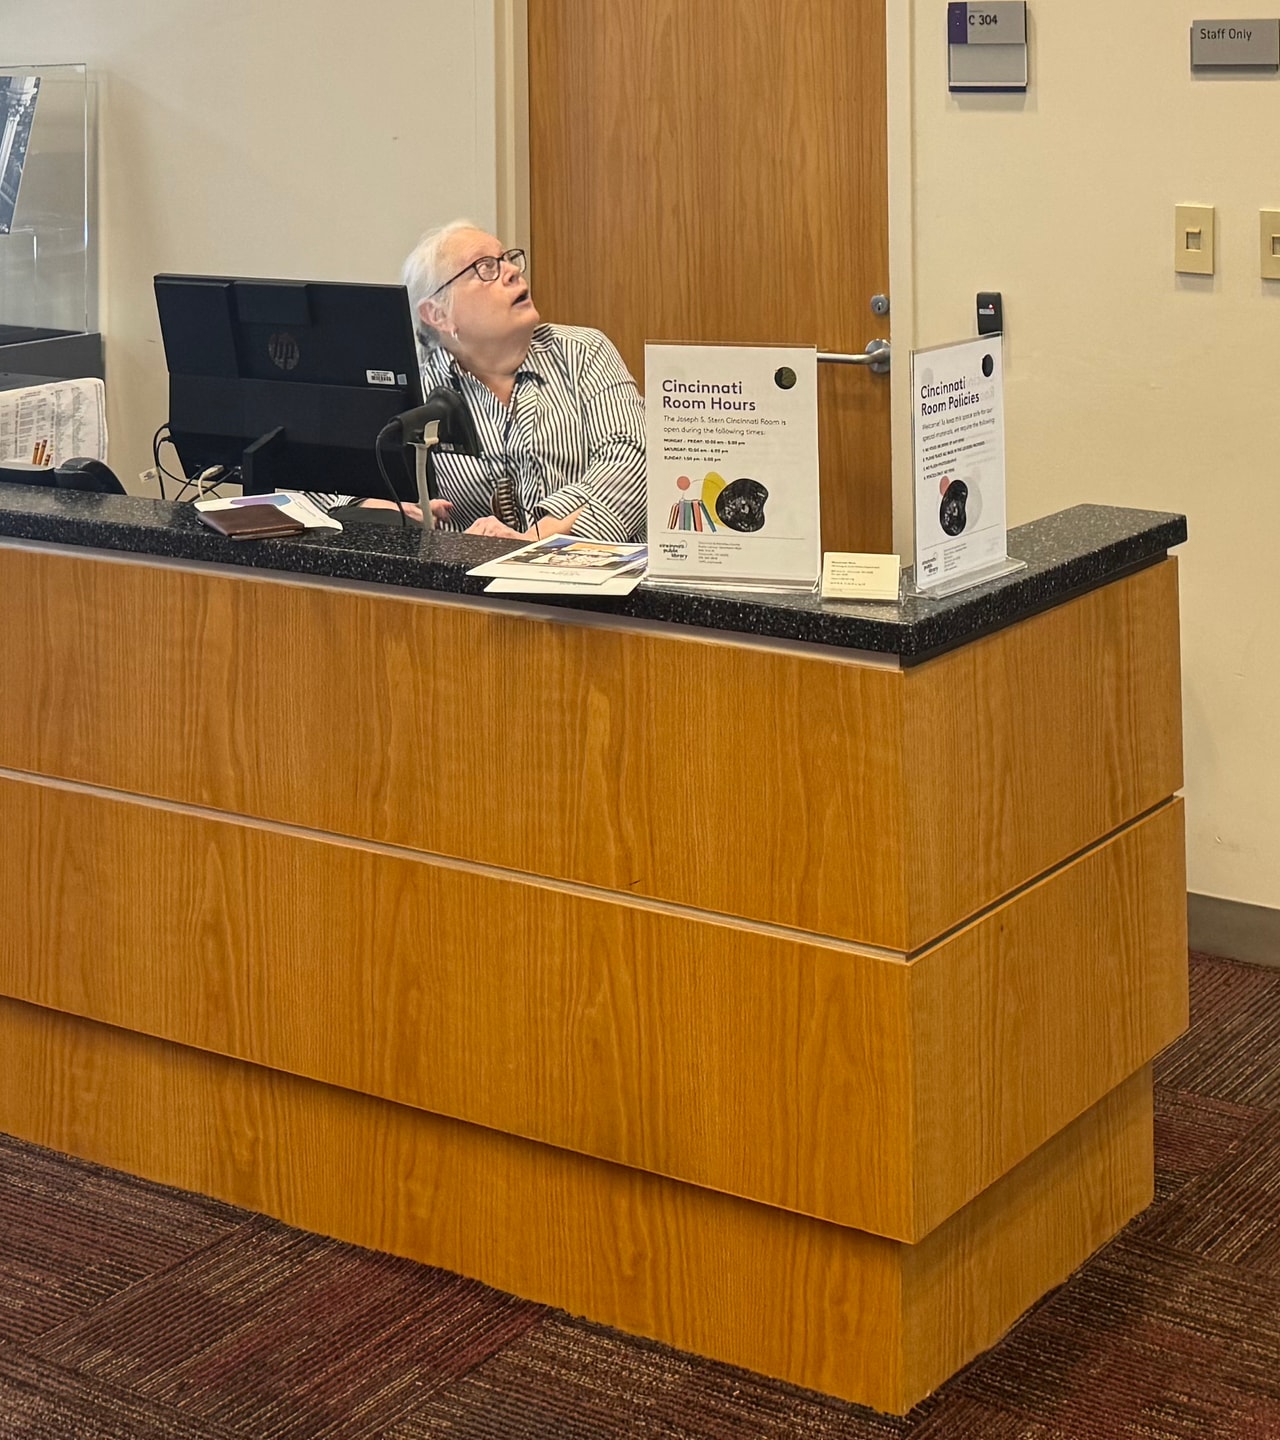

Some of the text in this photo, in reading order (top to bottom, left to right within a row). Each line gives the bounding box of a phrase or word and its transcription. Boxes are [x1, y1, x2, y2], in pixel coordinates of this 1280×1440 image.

[968, 14, 998, 26] C 304
[1200, 28, 1252, 42] Staff Only
[662, 379, 742, 394] Cincinnati
[921, 376, 966, 399] Cincinnati
[663, 396, 756, 411] Room Hours
[921, 392, 980, 416] Room Policies
[677, 416, 699, 424] Joseph
[726, 417, 759, 426] Cincinnati
[761, 418, 780, 426] Room
[681, 427, 701, 435] during
[715, 428, 745, 436] following
